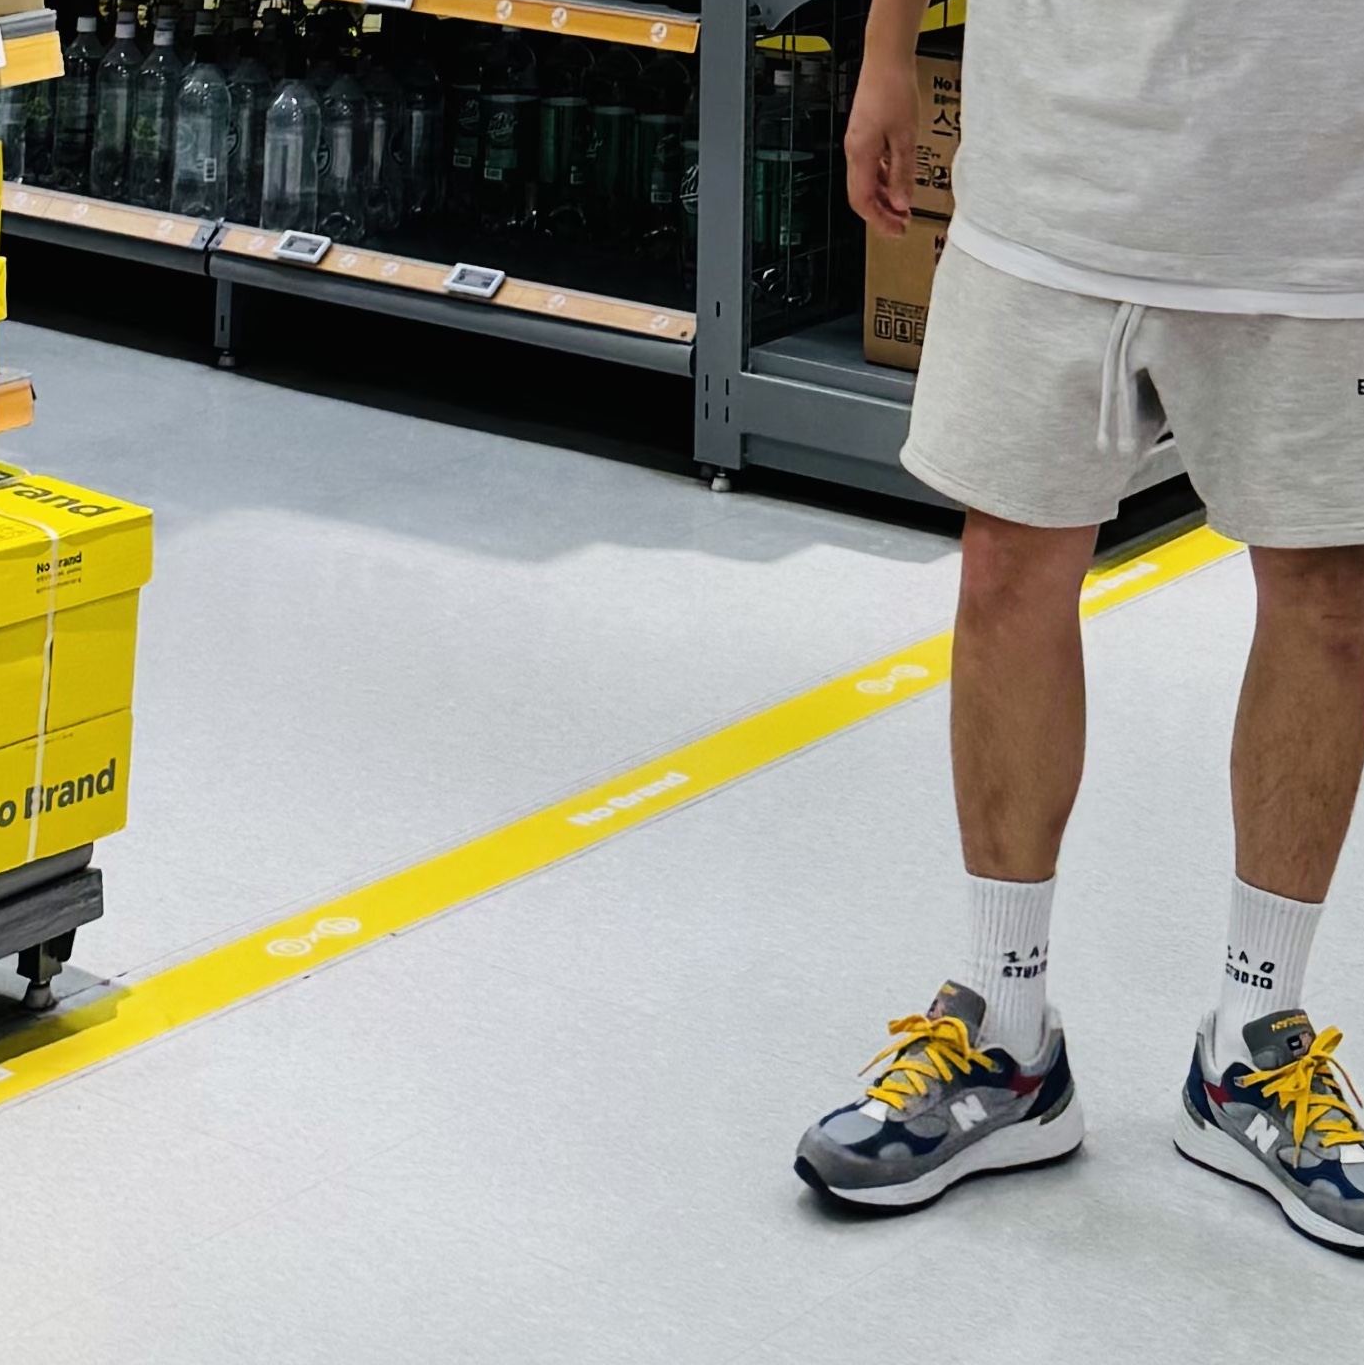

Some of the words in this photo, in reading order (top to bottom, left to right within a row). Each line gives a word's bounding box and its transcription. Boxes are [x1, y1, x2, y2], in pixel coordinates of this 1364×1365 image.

[24, 759, 115, 818] Brand
[950, 1093, 988, 1131] N
[1245, 1115, 1279, 1153] N
